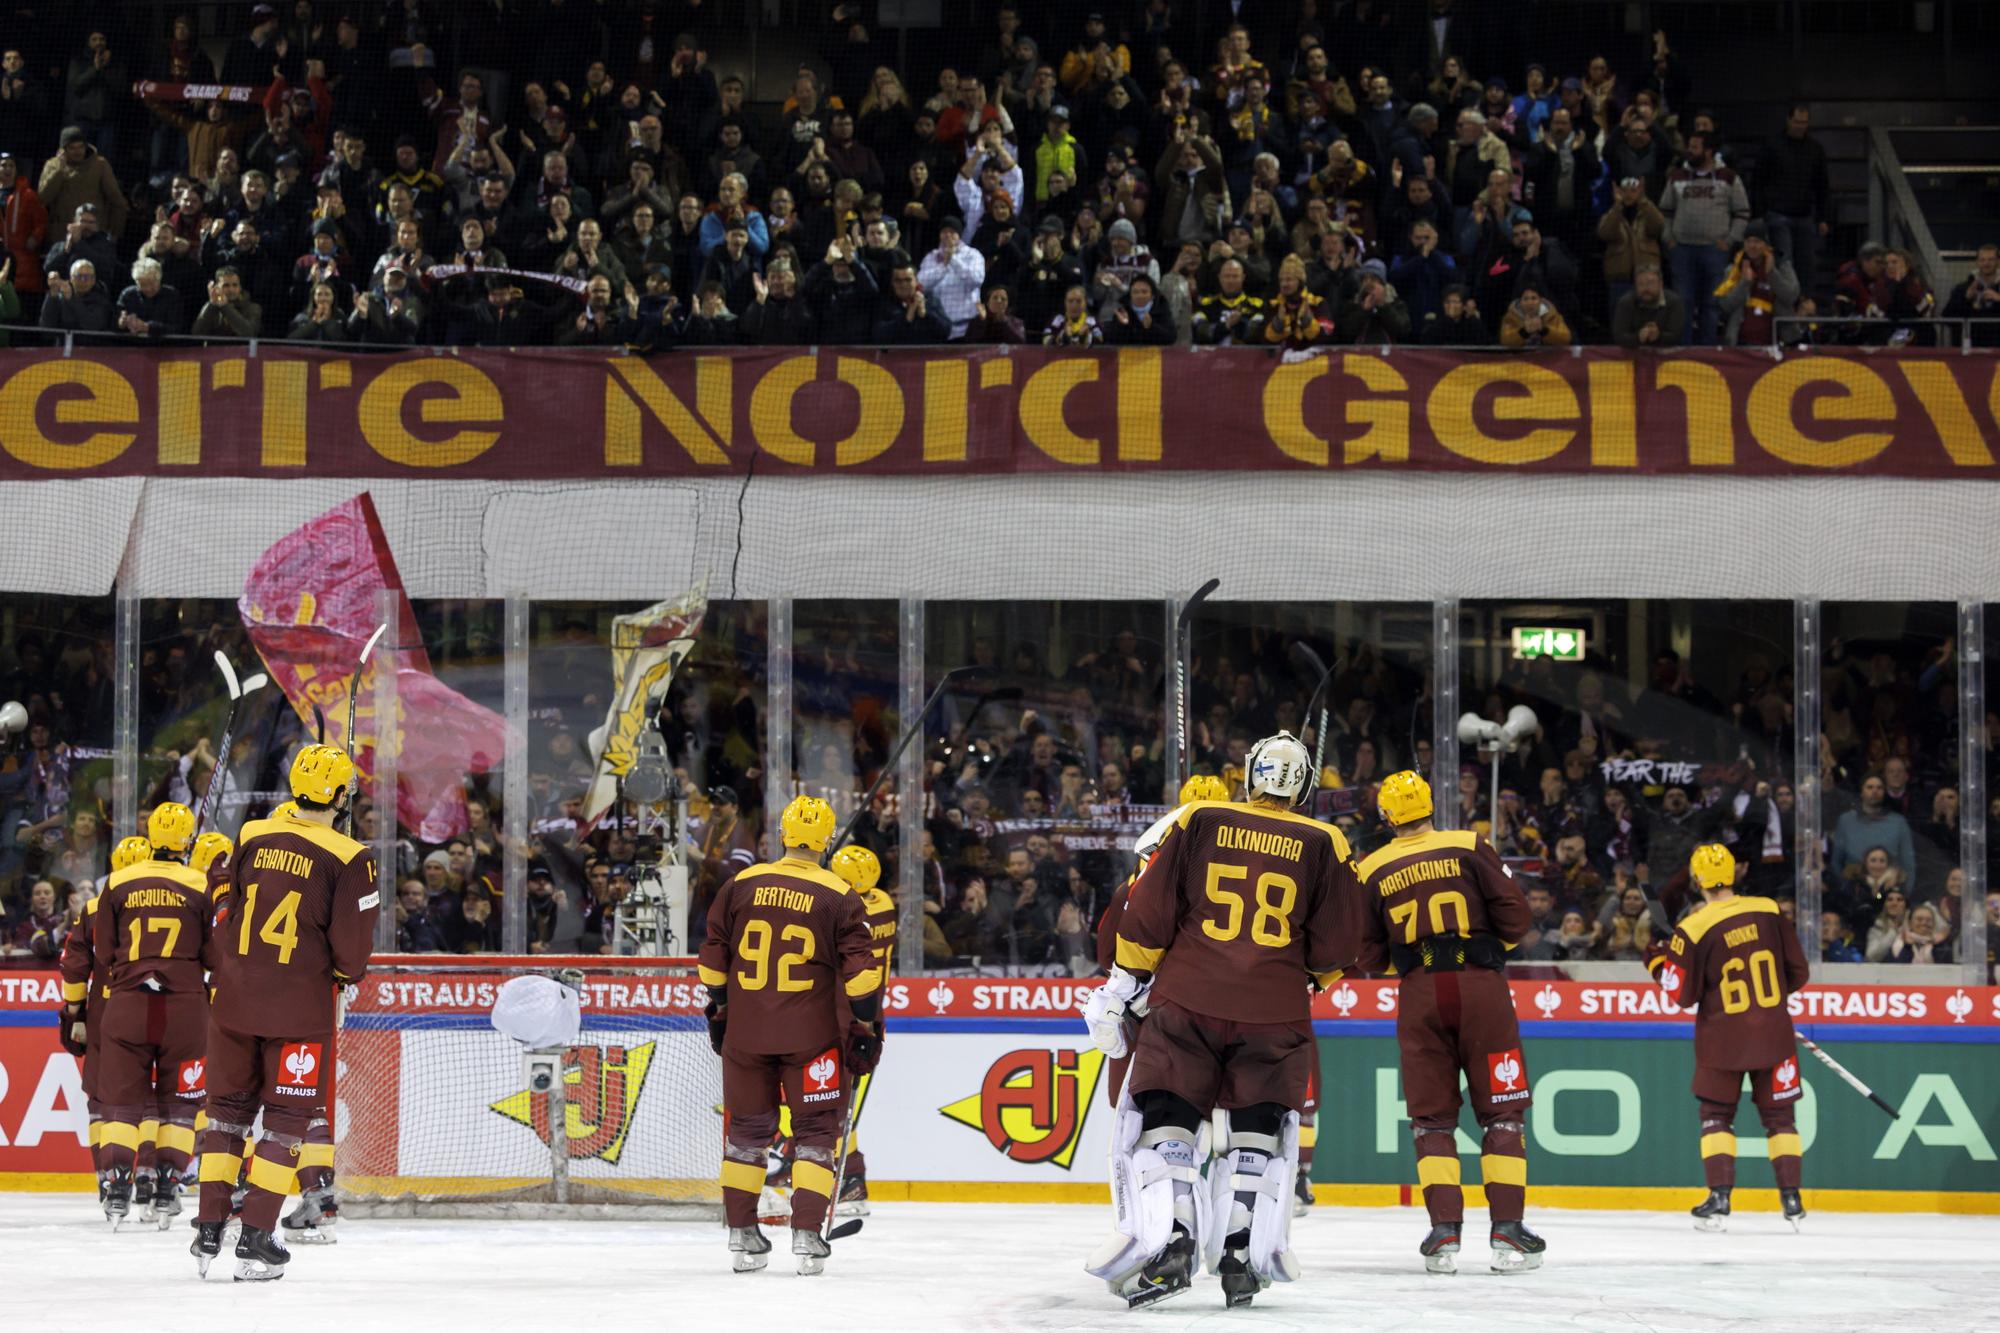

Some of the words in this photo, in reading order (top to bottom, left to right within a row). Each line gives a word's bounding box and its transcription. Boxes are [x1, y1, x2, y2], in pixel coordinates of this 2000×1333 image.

[604, 347, 1162, 467] Nord
[1600, 758, 1656, 785] FEAR
[1656, 761, 1702, 785] THE
[1216, 824, 1305, 863] OLKINUORA
[253, 848, 314, 880] CHANTON
[1378, 858, 1462, 897] HARTIKAINEN
[753, 886, 815, 914] BERTHON
[1201, 862, 1298, 948] 58
[1388, 890, 1472, 945] 70
[128, 916, 182, 962] 17
[238, 883, 303, 965] 14
[738, 919, 816, 992] 92
[1719, 949, 1781, 1012] 60
[1786, 991, 1927, 1019] STRAUSS
[275, 1086, 317, 1098] STRAUSS
[802, 1089, 841, 1103] STRAUSS
[1491, 1090, 1529, 1104] STRAUSS
